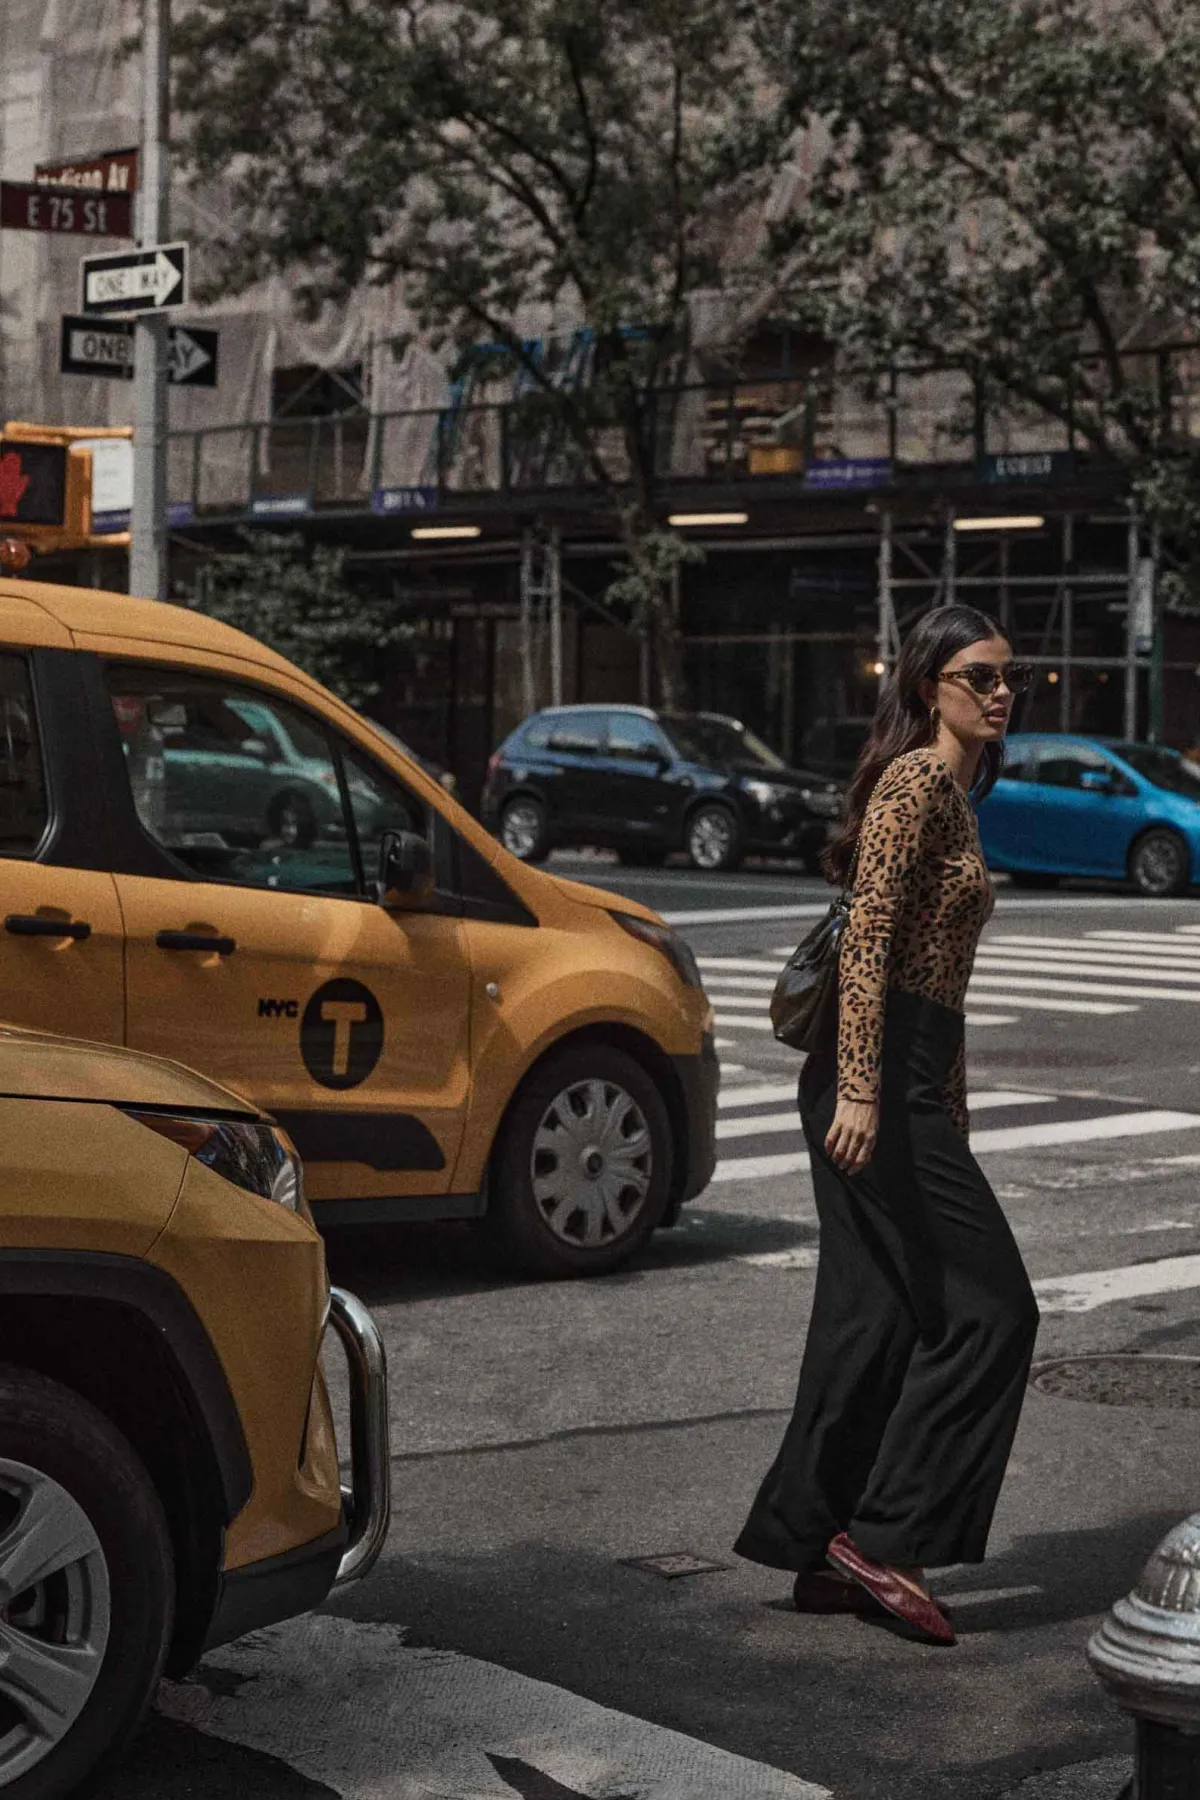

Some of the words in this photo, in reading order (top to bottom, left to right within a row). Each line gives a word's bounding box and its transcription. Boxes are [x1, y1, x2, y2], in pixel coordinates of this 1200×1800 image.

[27, 195, 40, 227] E
[48, 197, 75, 229] 75
[83, 199, 107, 232] St
[95, 271, 125, 298] ONE
[140, 271, 168, 289] WAY
[83, 332, 128, 361] ONE
[258, 999, 298, 1016] NYC
[321, 1002, 366, 1074] T
